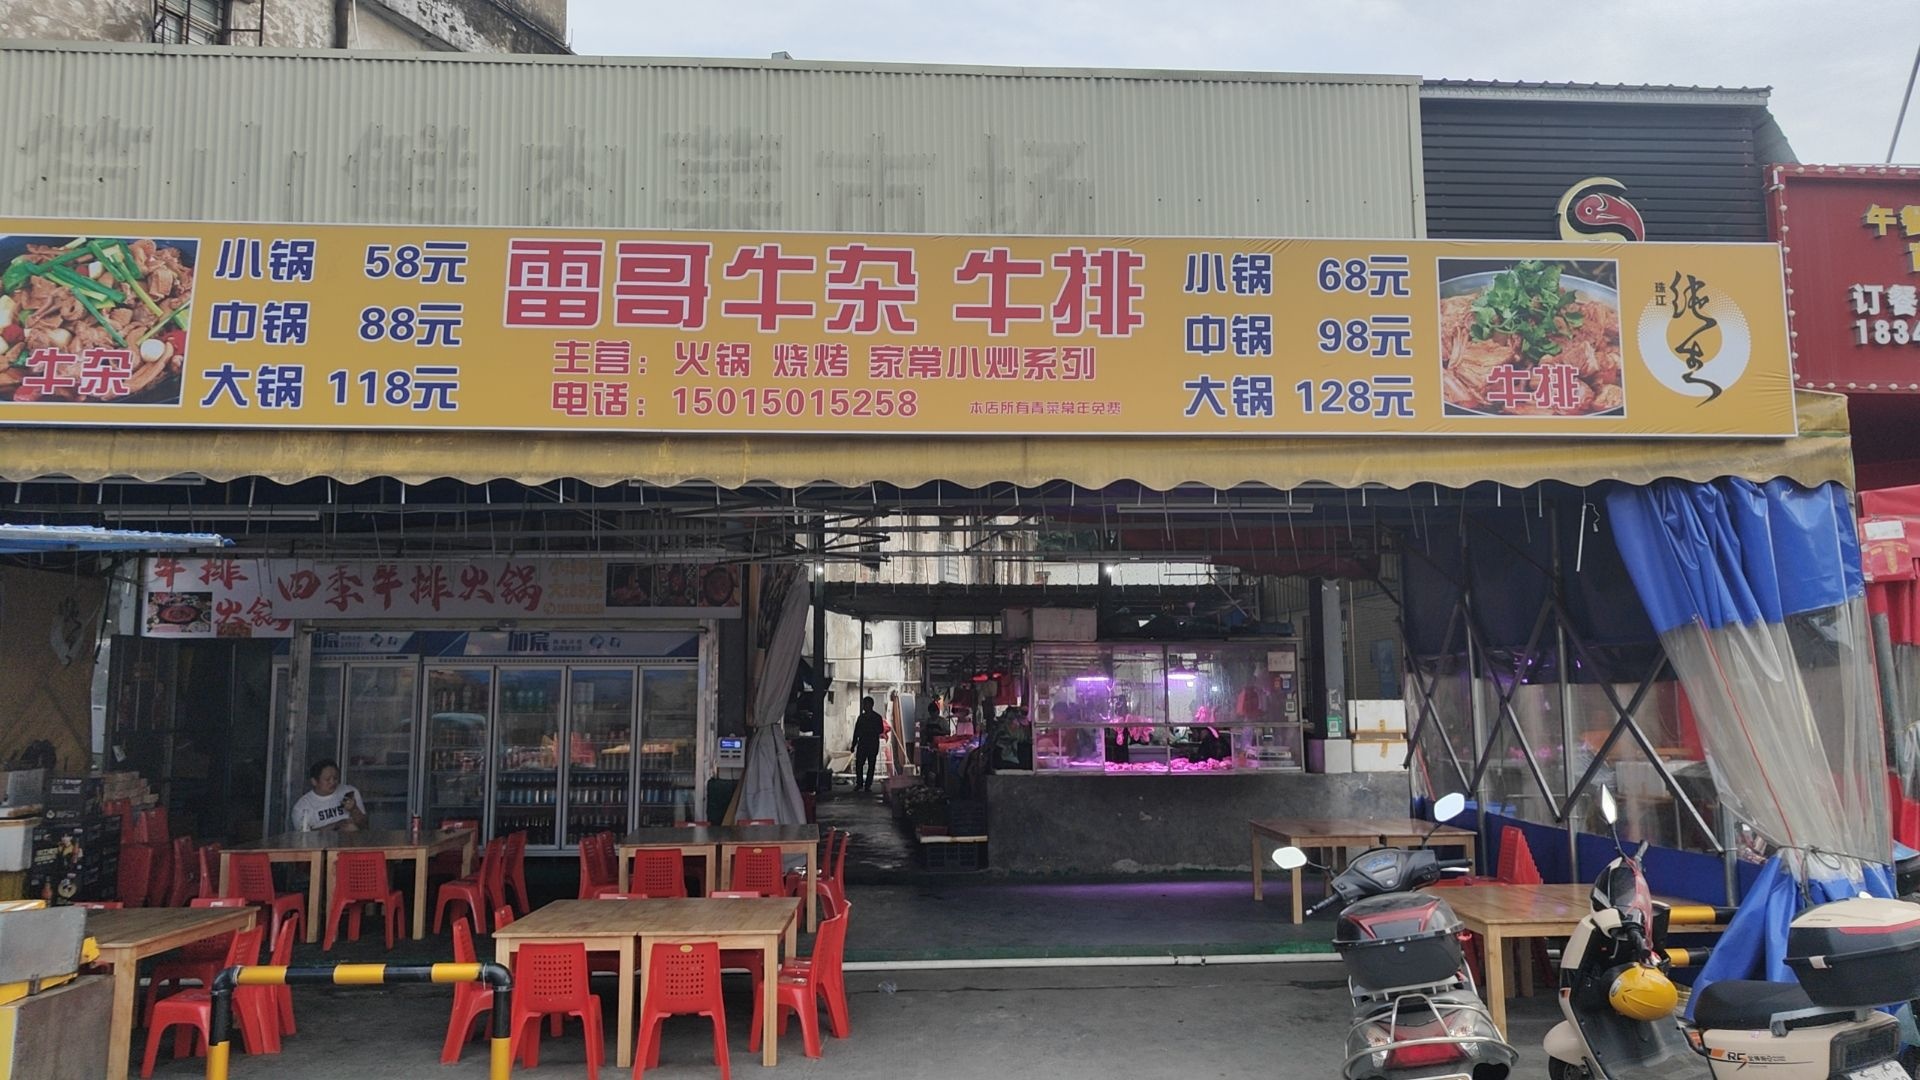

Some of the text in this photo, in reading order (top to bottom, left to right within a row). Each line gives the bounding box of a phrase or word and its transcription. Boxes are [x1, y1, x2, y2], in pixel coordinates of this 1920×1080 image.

[215, 238, 468, 284] 小锅 58元
[1183, 251, 1411, 297] 小锅 68元
[503, 237, 1145, 338] 雷哥牛杂 牛排
[1852, 282, 1919, 316] 订餐
[209, 301, 463, 347] 中锅 88元
[1184, 314, 1411, 358] 中锅 98元
[21, 346, 133, 396] 牛杂
[673, 341, 752, 378] 火锅
[773, 343, 848, 379] 烧烤
[868, 344, 1097, 382] 家常小炒系列
[200, 364, 460, 410] 大锅 118元
[672, 387, 918, 418] 15015015258
[969, 401, 1122, 415] 本店所有青菜常年免费
[1182, 375, 1415, 419] 大锅 128元
[1486, 362, 1581, 411] 牛排
[277, 563, 543, 612] 四季牛排火锅
